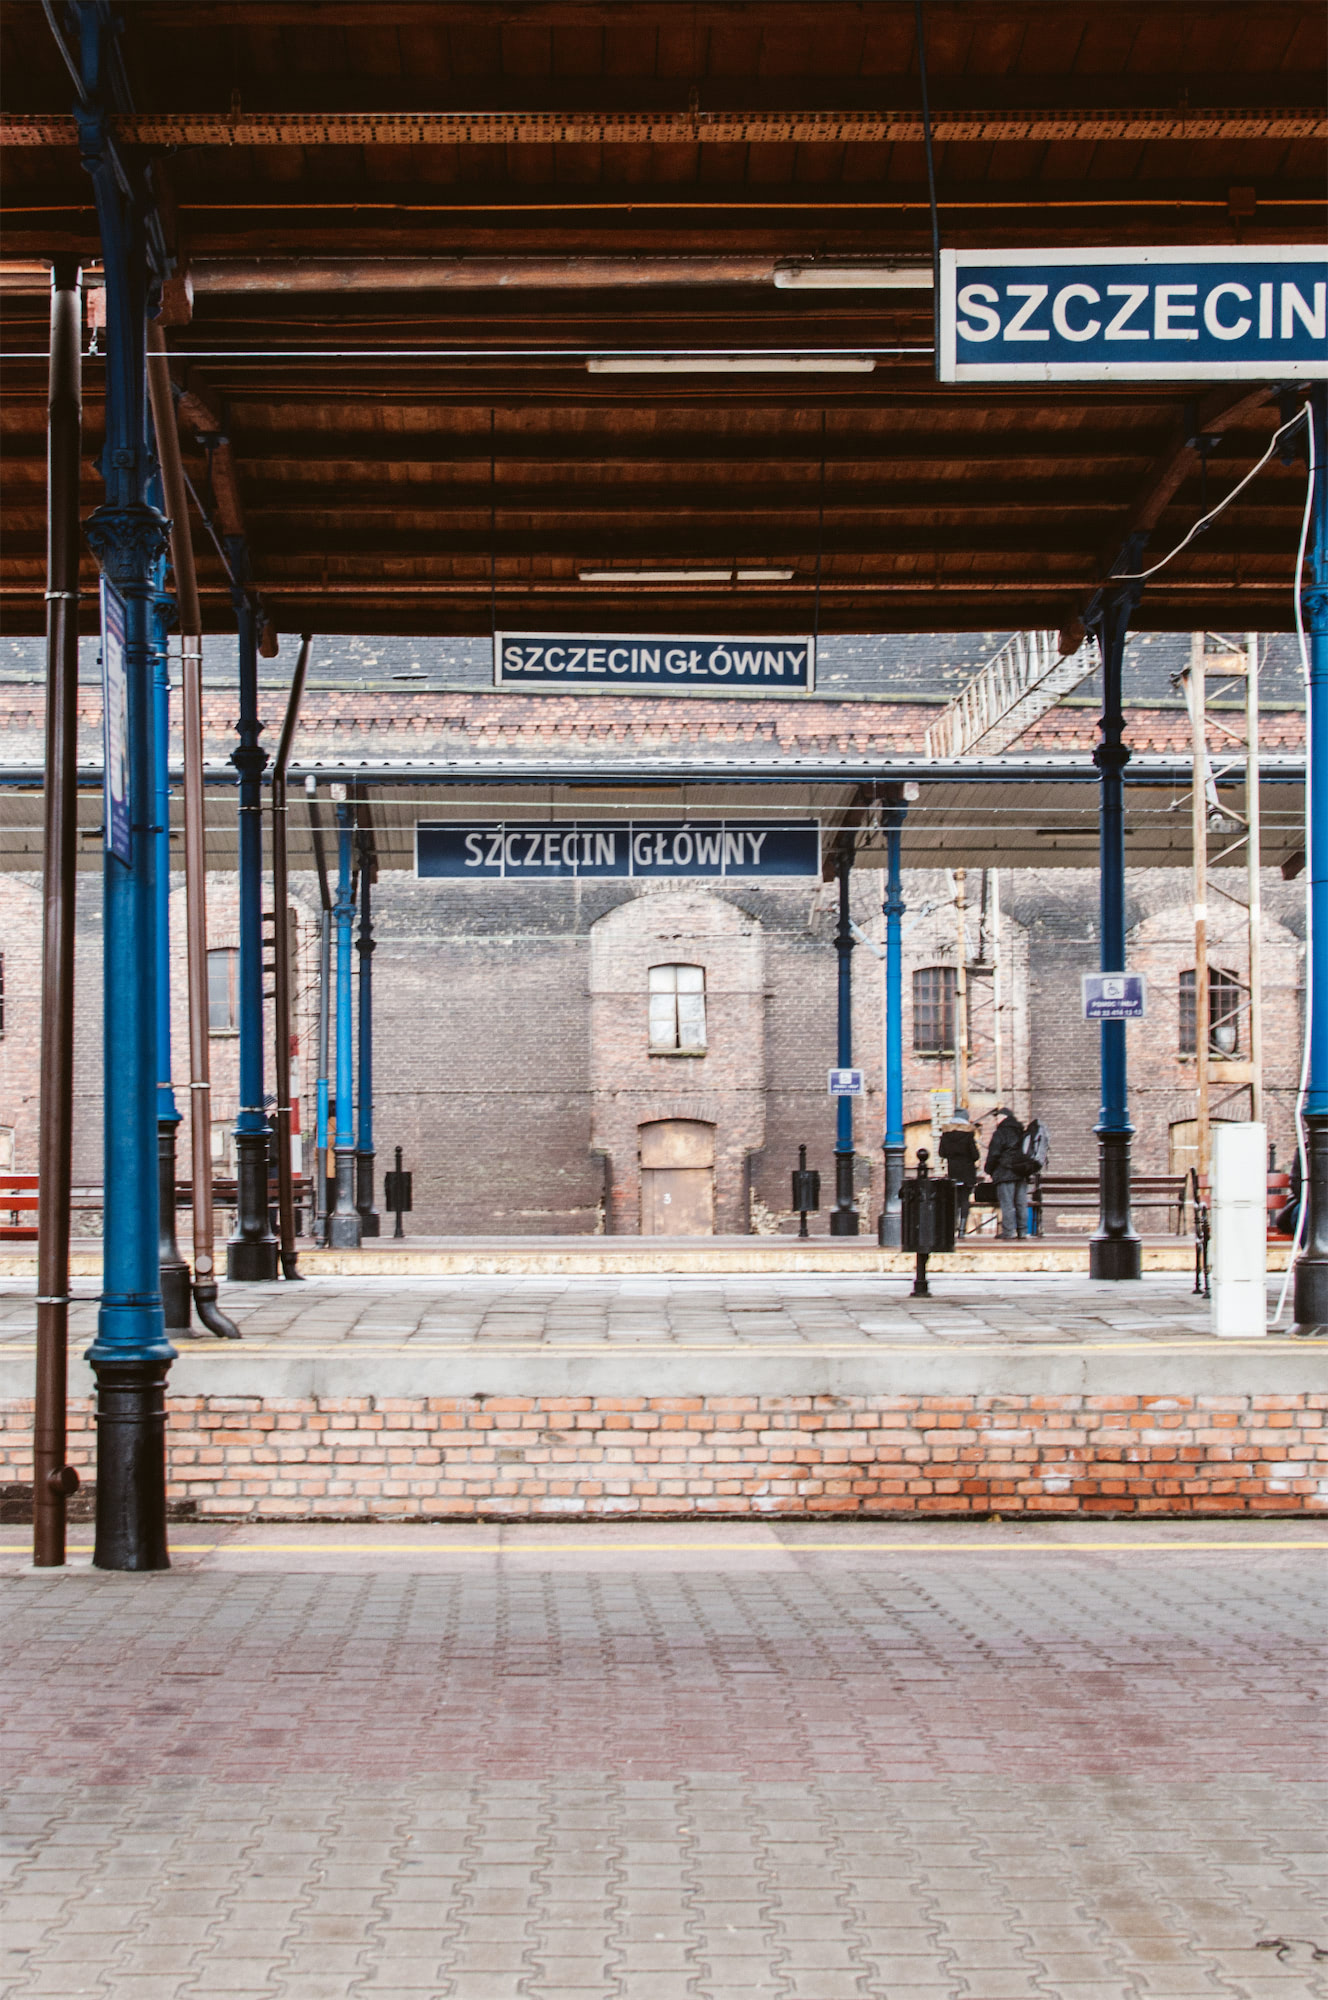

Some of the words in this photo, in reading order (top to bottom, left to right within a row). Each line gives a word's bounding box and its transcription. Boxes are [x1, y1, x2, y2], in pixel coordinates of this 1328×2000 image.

[956, 283, 1327, 342] SZCZECIN
[503, 646, 661, 674] SZCZECIN
[664, 645, 807, 676] GŁÓWNY
[464, 832, 616, 867] SZCZECIN
[633, 824, 768, 866] GŁÓWNY
